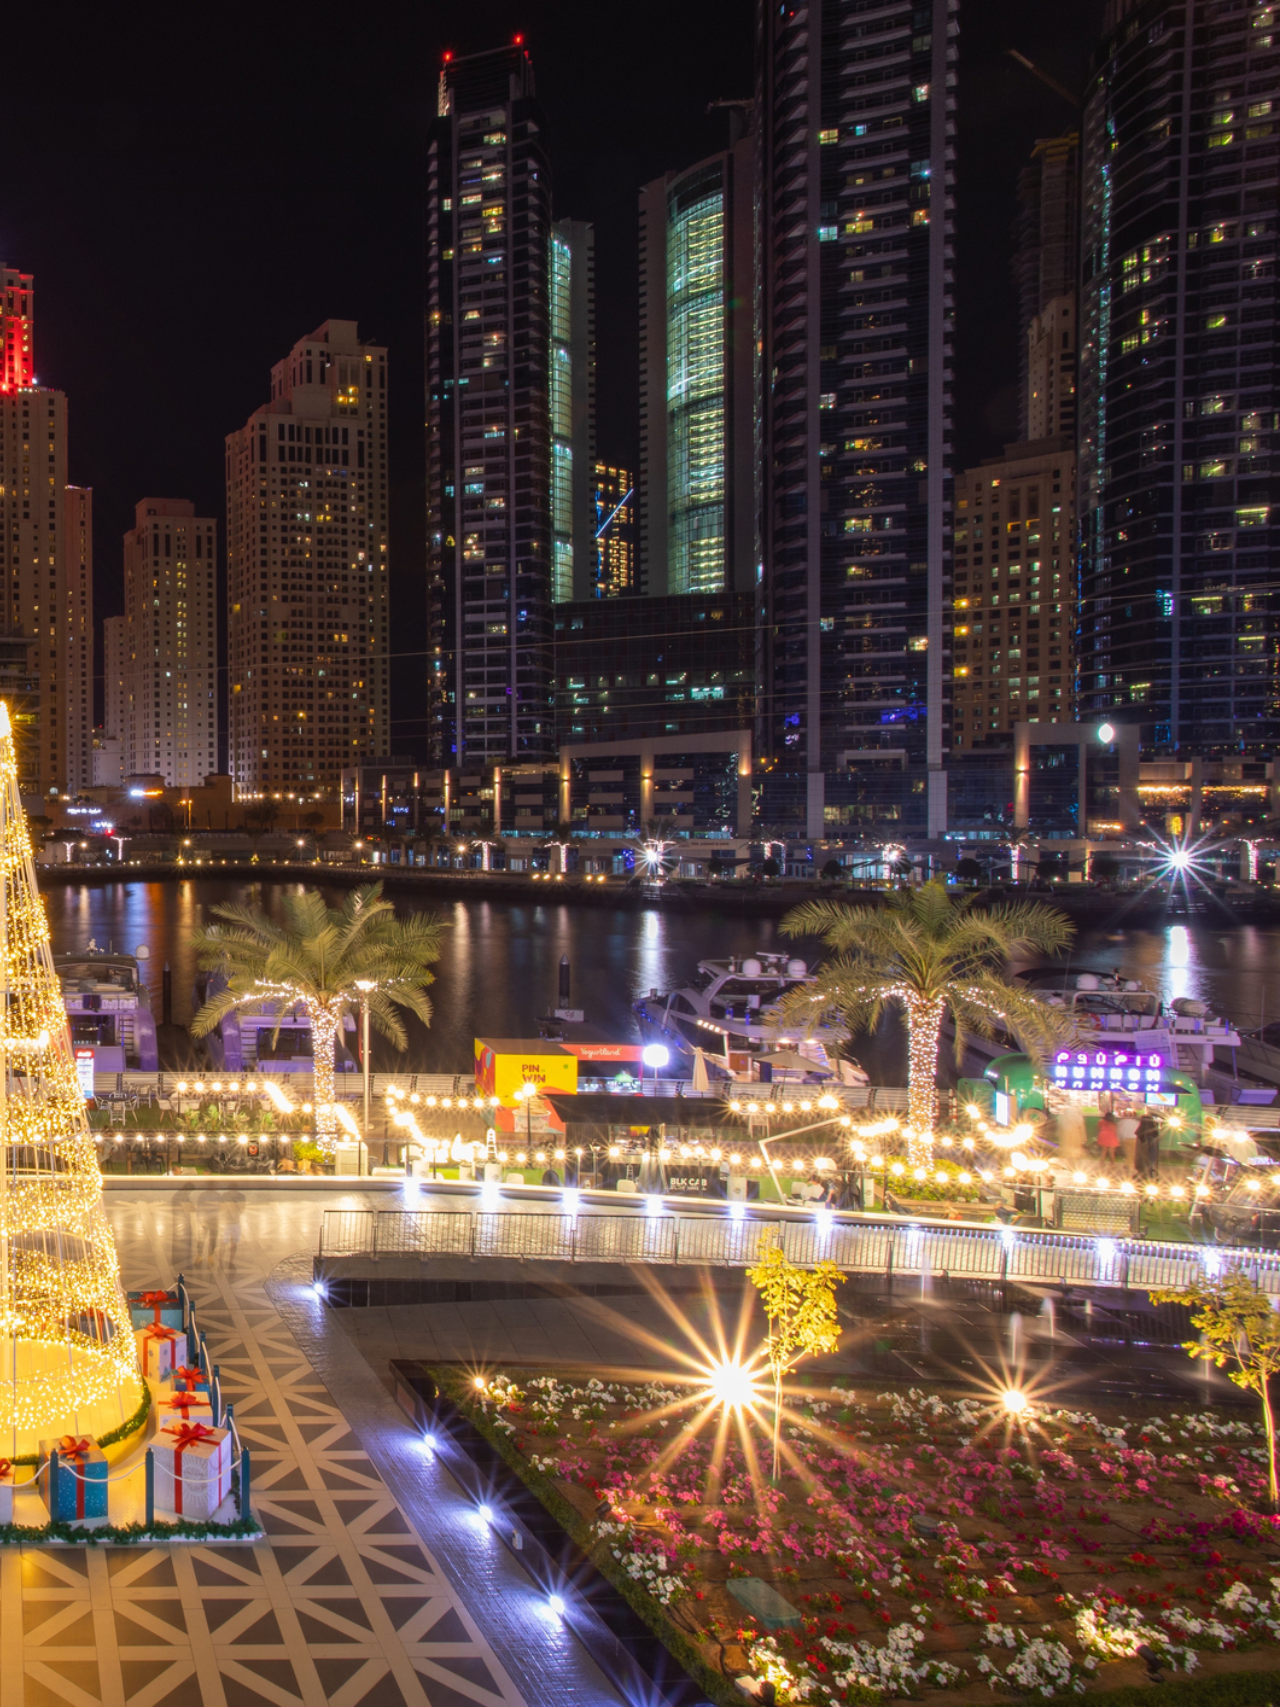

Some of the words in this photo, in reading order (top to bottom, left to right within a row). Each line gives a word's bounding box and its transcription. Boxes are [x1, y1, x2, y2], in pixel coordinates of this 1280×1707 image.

[580, 1047, 622, 1059] Yogurtland
[522, 1064, 540, 1072] PIN
[522, 1074, 546, 1083] WIN
[670, 1177, 687, 1186] BLK
[688, 1178, 707, 1187] CAB
